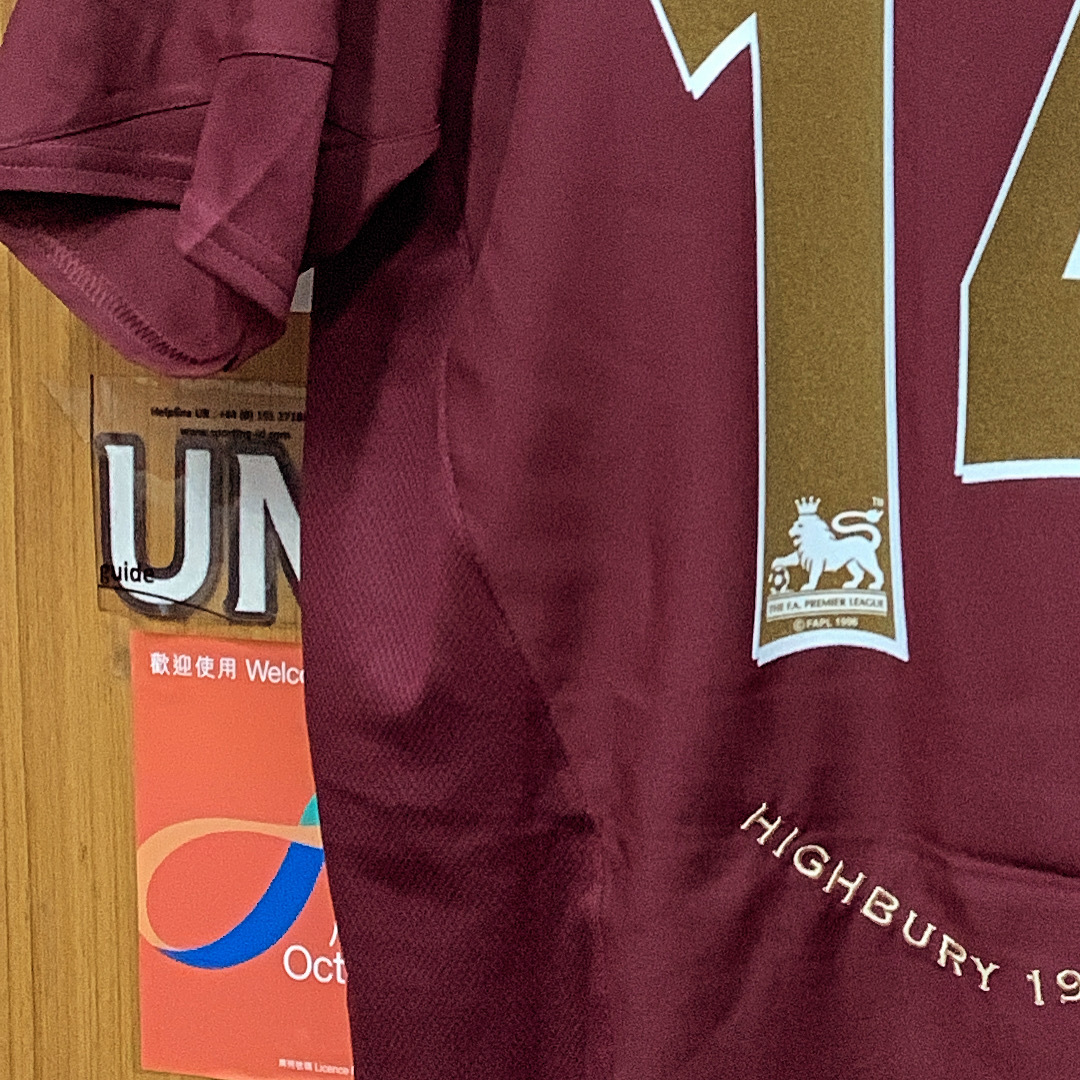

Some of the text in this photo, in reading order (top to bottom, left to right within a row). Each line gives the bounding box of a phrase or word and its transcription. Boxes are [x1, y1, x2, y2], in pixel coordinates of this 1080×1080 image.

[100, 560, 155, 586] guide
[804, 598, 846, 609] PREMIER
[849, 597, 884, 608] LEAGUE
[150, 651, 238, 680] 歡迎使用
[740, 802, 1000, 991] HIGHBURY
[283, 944, 346, 985] Oct
